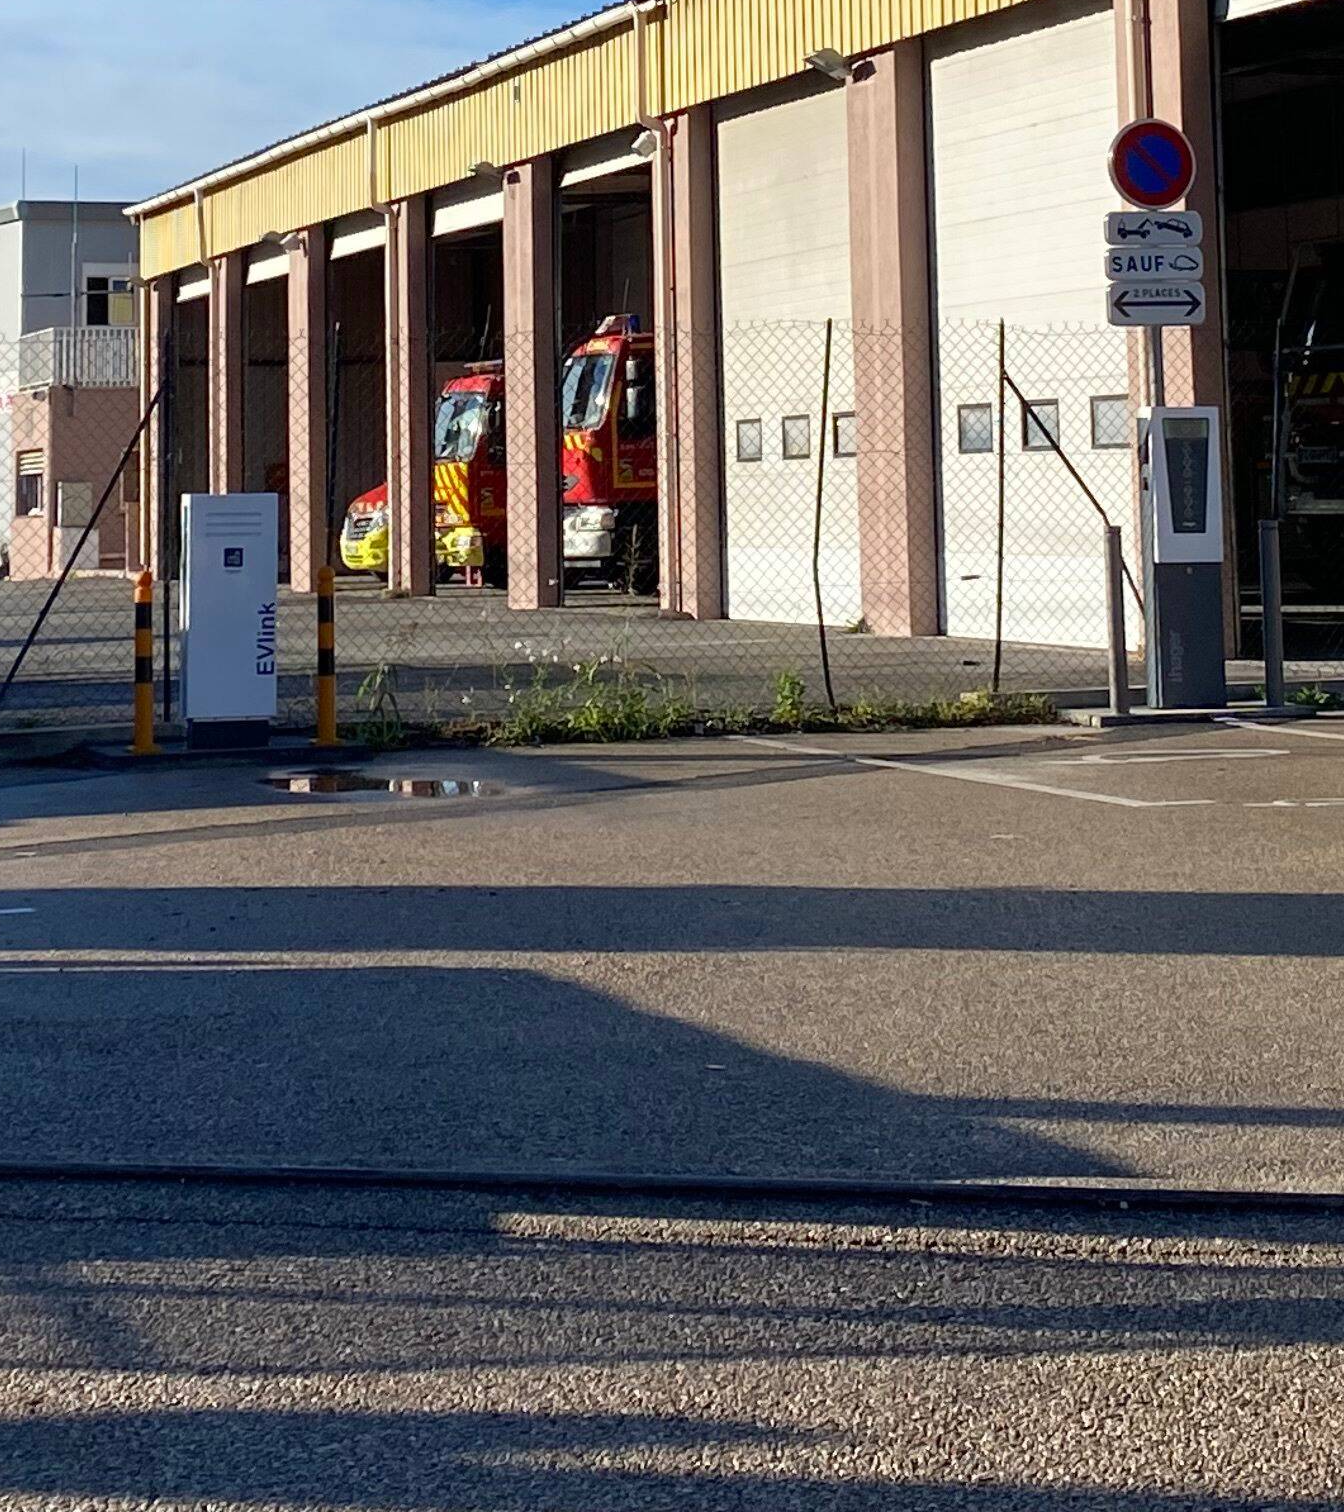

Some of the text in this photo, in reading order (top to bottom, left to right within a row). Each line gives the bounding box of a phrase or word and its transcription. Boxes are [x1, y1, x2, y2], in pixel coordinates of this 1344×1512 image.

[1112, 255, 1164, 273] SAUF
[1133, 288, 1181, 298] 2 PLACES
[257, 602, 276, 675] EVlink
